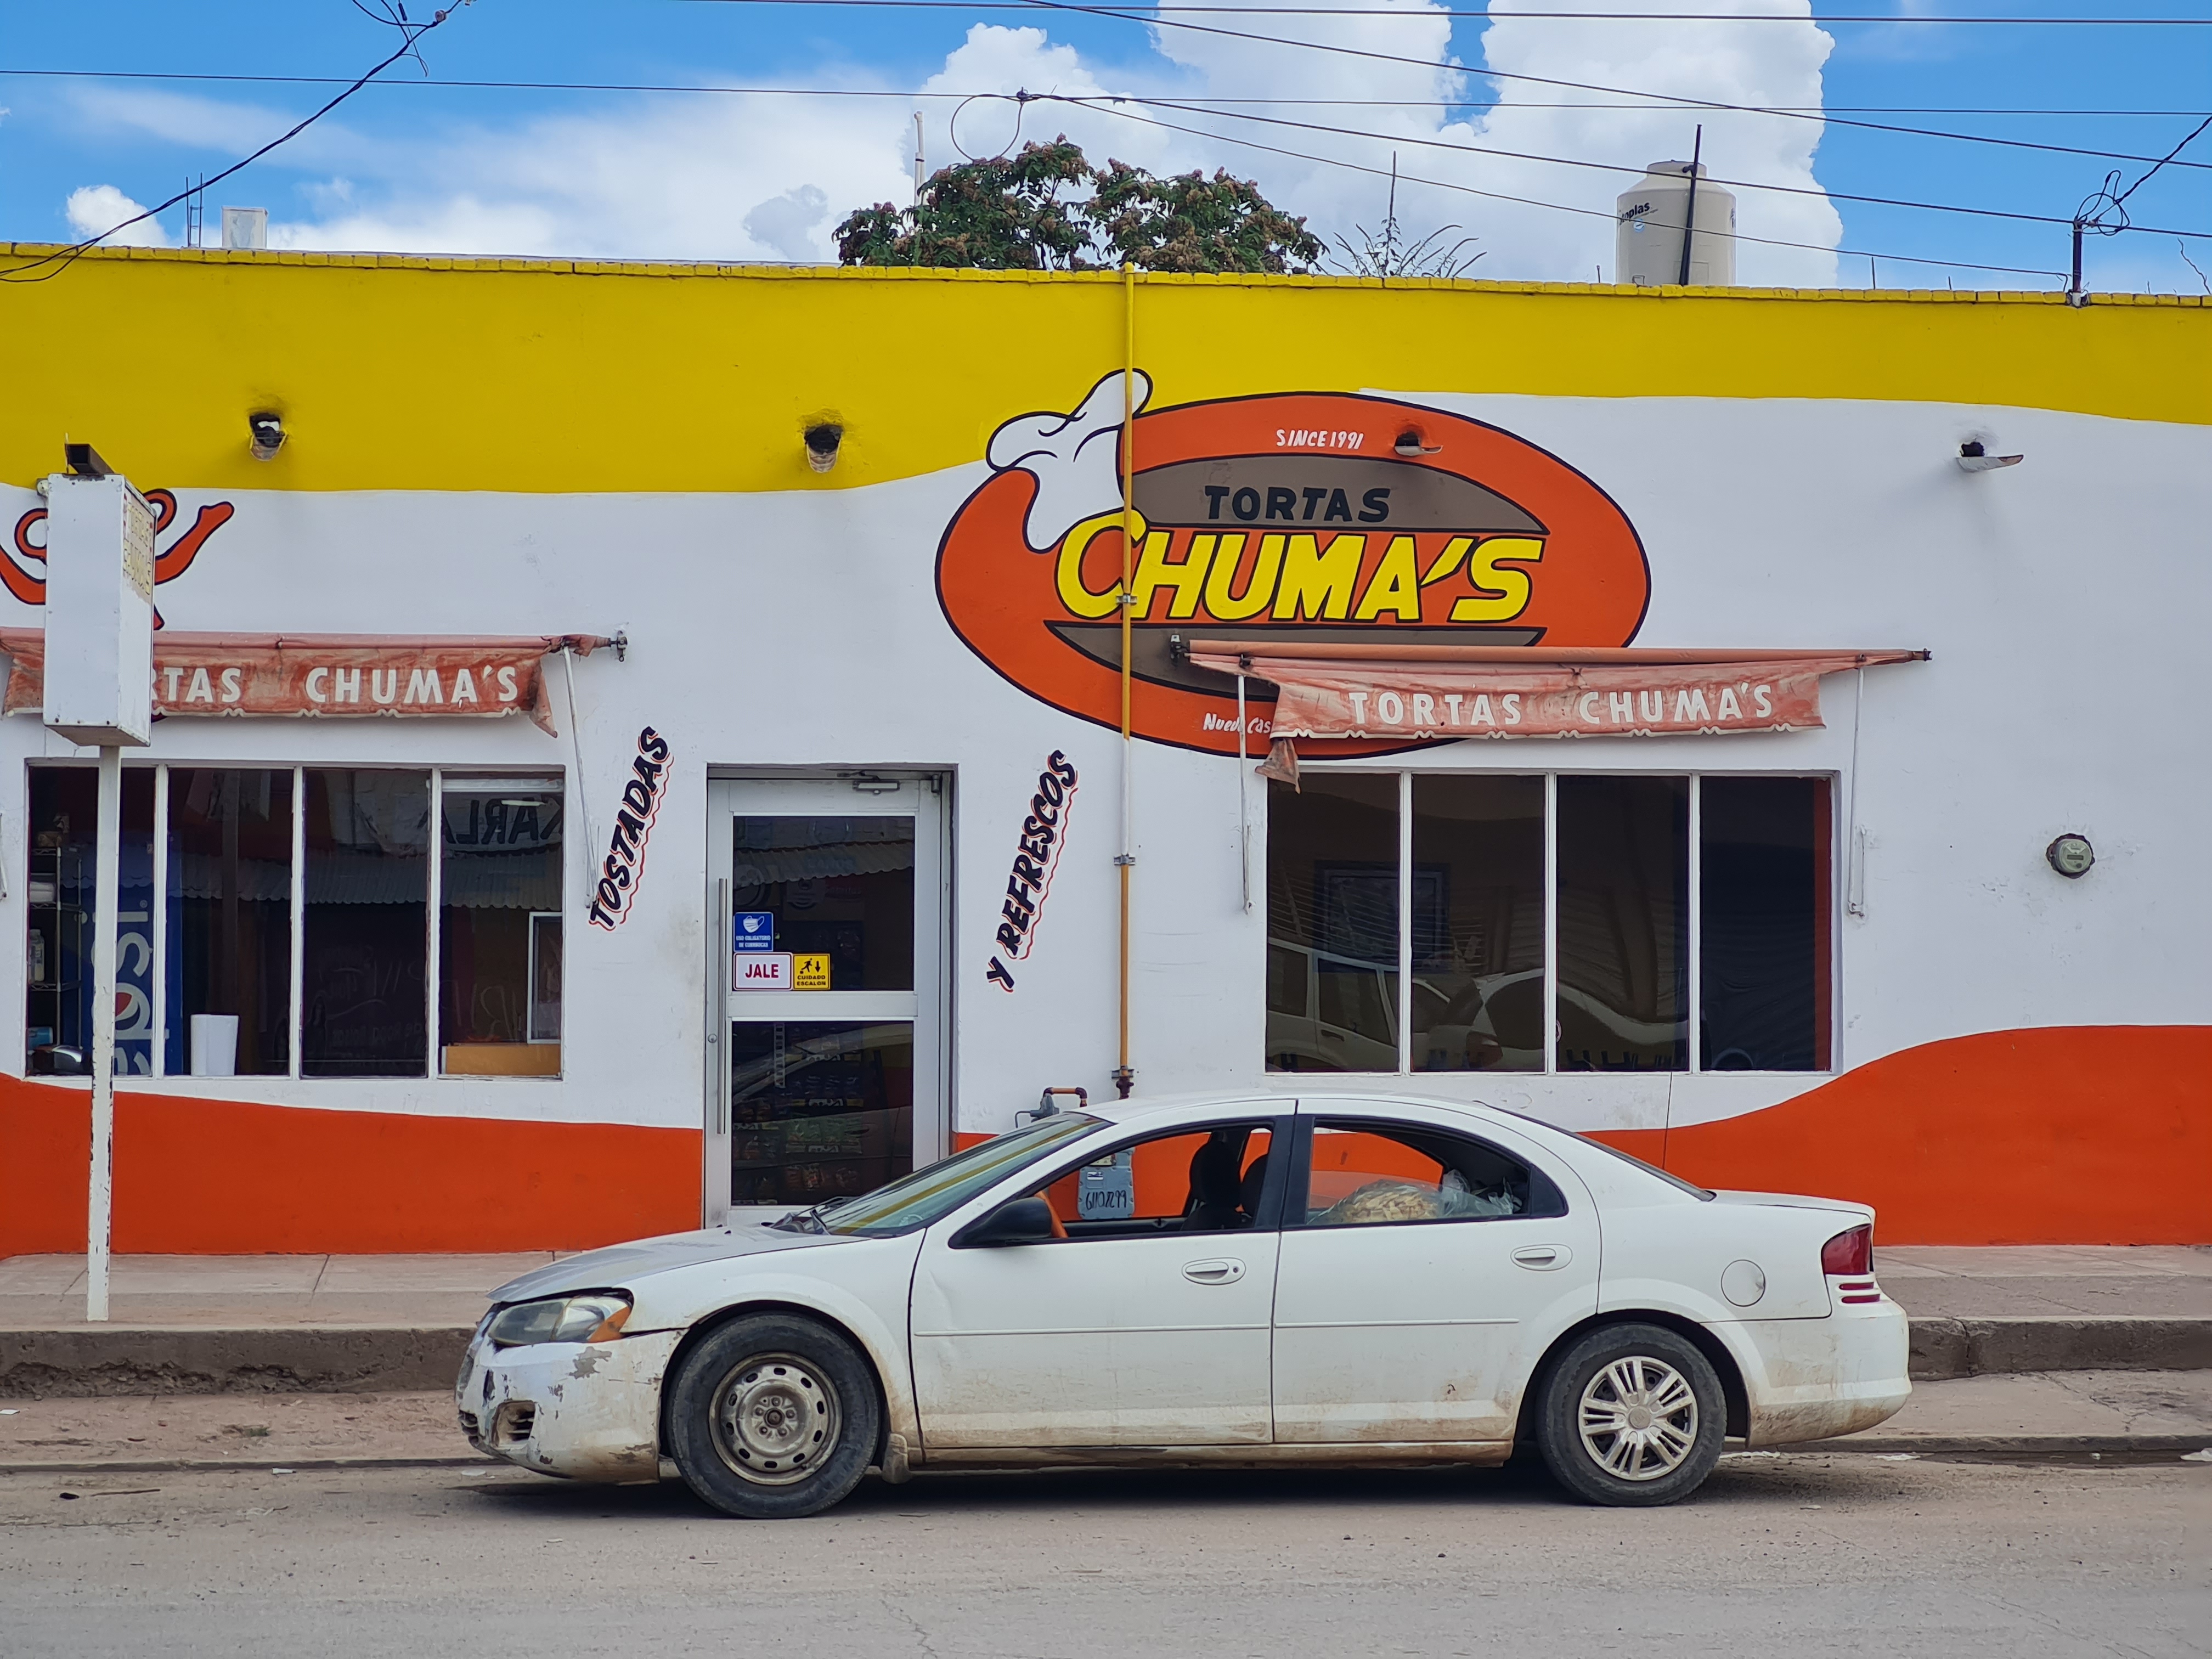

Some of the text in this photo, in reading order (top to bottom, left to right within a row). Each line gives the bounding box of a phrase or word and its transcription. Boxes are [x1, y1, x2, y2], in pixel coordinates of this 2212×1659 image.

[1276, 429, 1364, 449] SINCE 1991
[1204, 485, 1391, 522] TORTAS
[1055, 508, 1545, 623] CHUMA'S
[151, 665, 518, 703] TAS CHUMA'S
[1203, 712, 1272, 734] Nuev Cas
[1348, 680, 1773, 729] TORTAS CHUMA'S
[589, 726, 669, 928] TOSTADAS
[986, 749, 1076, 990] Y REFRESCOS
[745, 964, 779, 978] JALE
